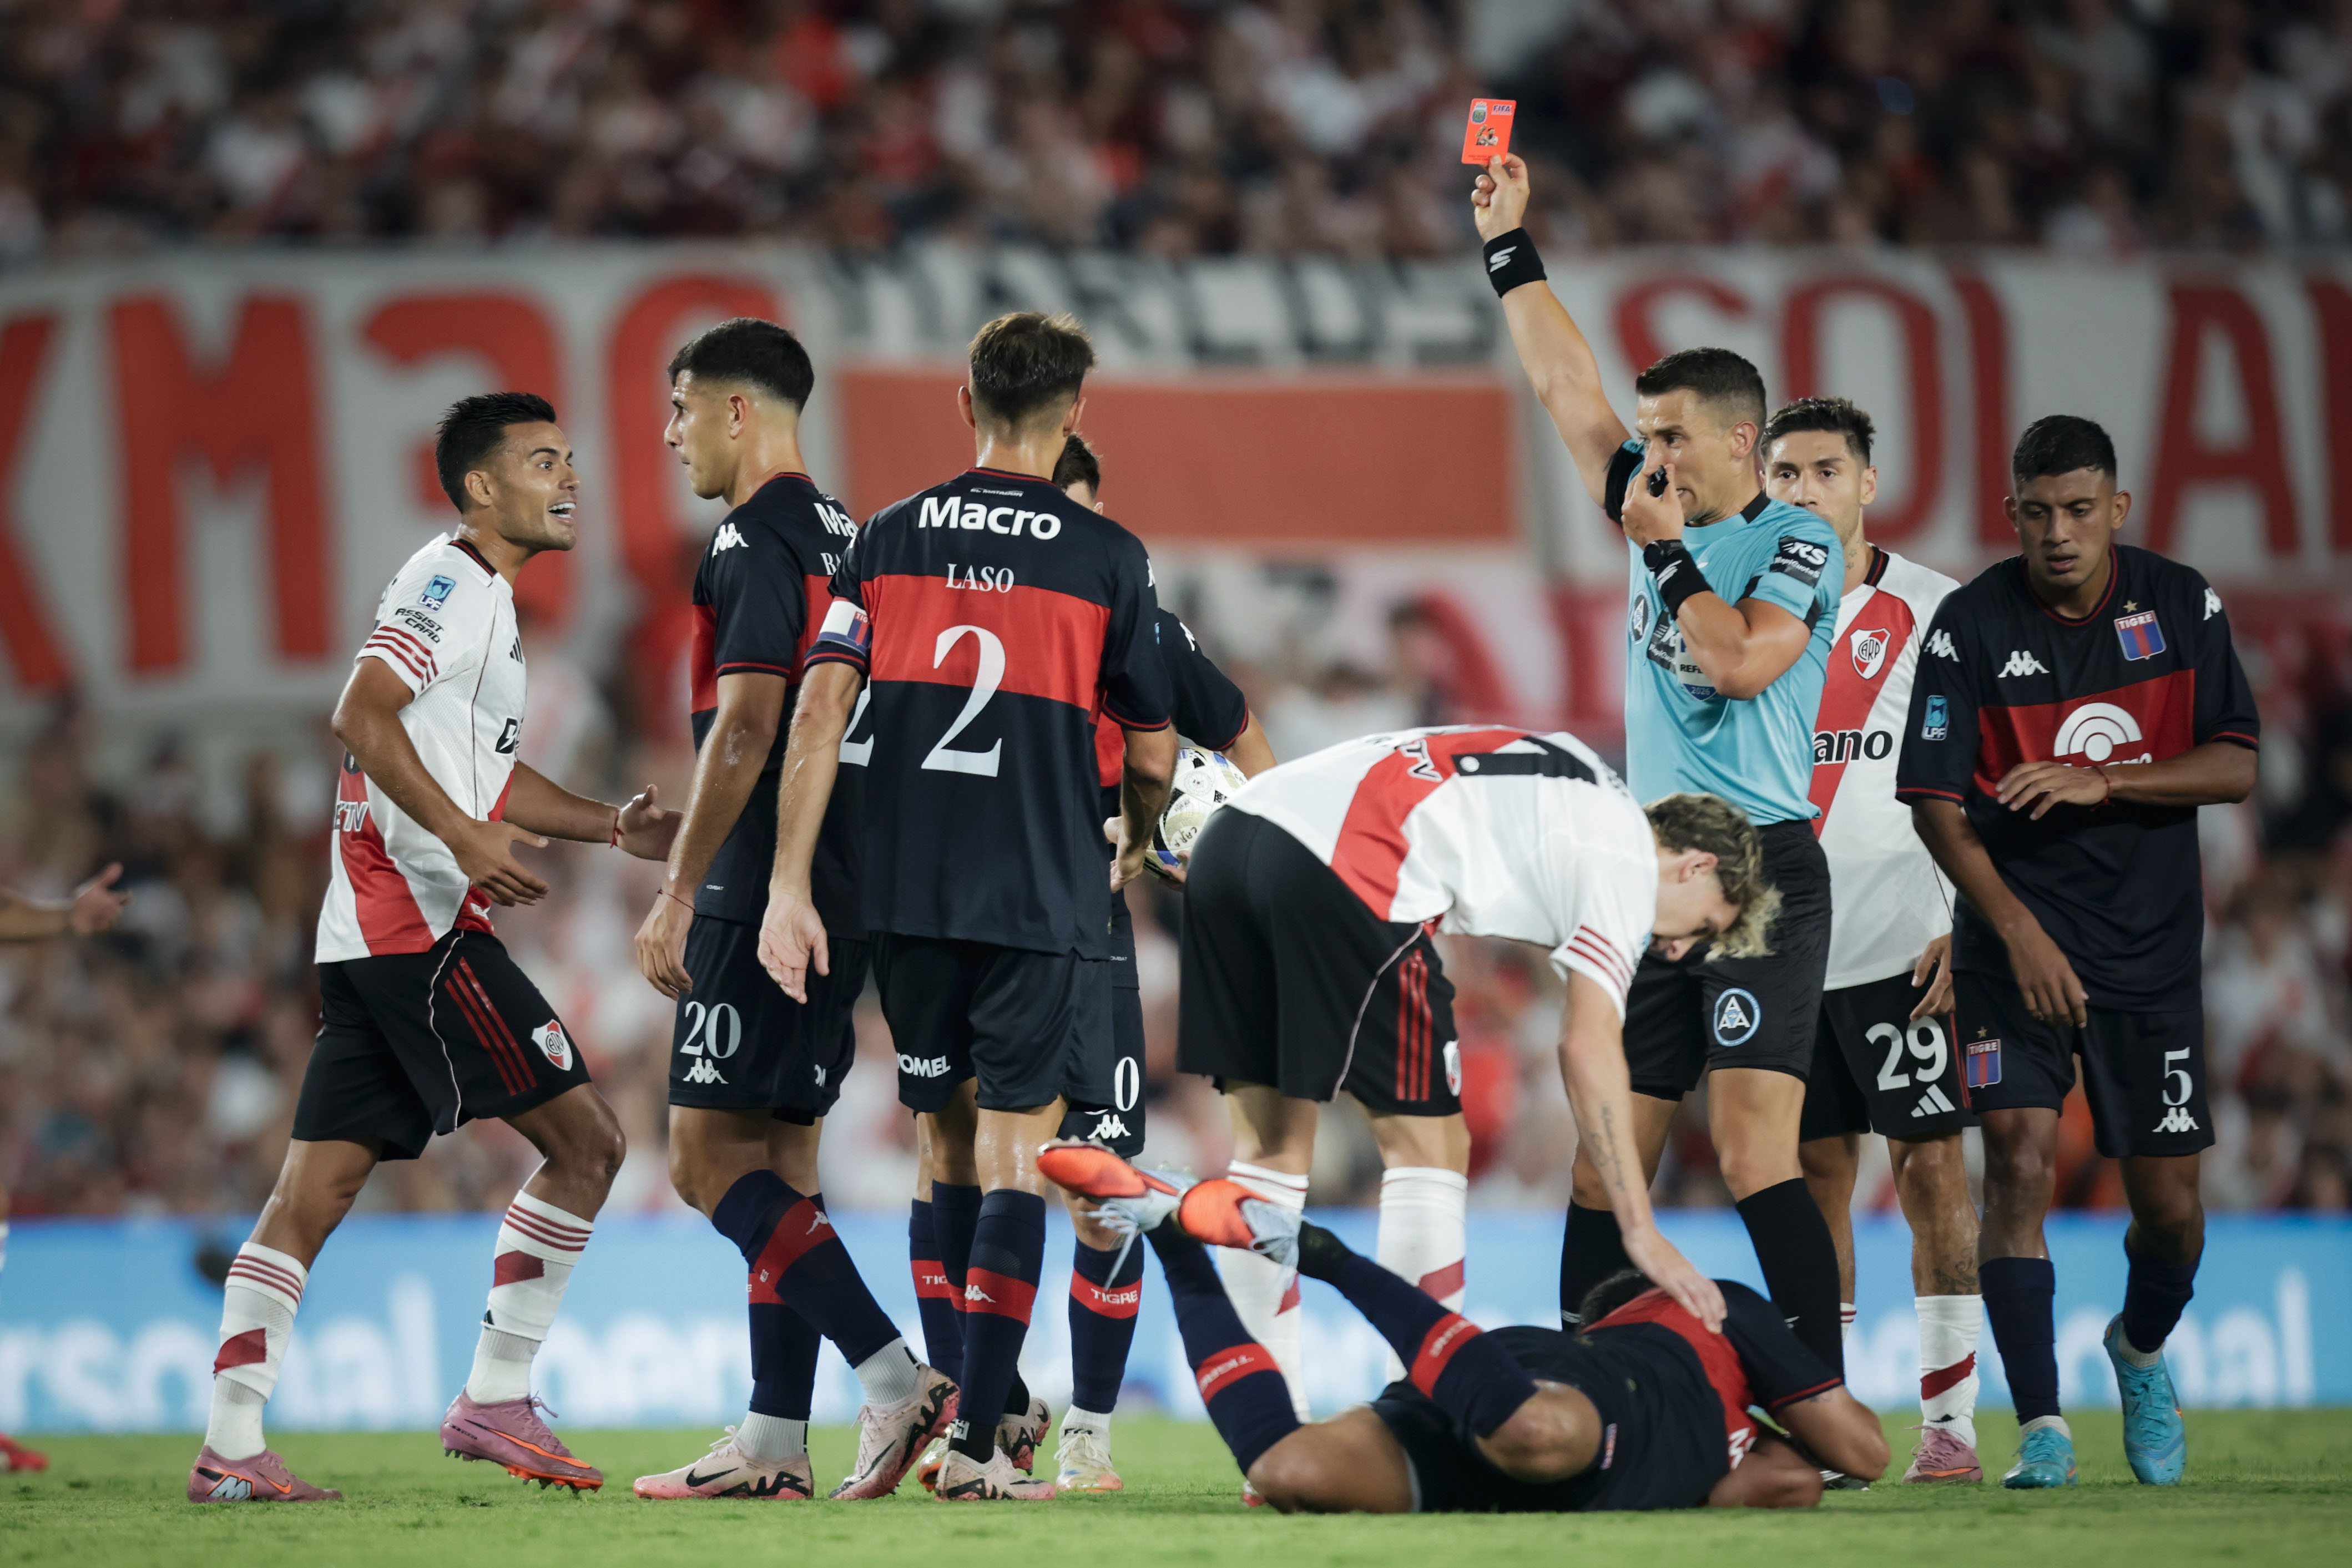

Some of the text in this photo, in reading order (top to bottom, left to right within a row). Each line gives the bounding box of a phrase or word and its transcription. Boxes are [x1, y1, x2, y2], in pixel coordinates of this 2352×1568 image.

[918, 496, 1062, 540] Macro
[945, 563, 1015, 594] LASO
[419, 594, 443, 609] LPF
[395, 608, 445, 631] ASSIST
[856, 612, 870, 624] TIG
[2118, 613, 2154, 630] TIGRE
[405, 618, 441, 644] CARD
[1858, 639, 1881, 661] CARP
[921, 625, 1006, 777] 2
[1691, 686, 1711, 695] 2026
[1924, 726, 1946, 739] LPF
[680, 1001, 742, 1059] 20
[1865, 1015, 1948, 1091] 29
[1969, 1041, 1998, 1055] TIGRE
[897, 1052, 951, 1078] OMEL
[2162, 1046, 2193, 1106] 5
[1091, 1287, 1139, 1305] TIGRE
